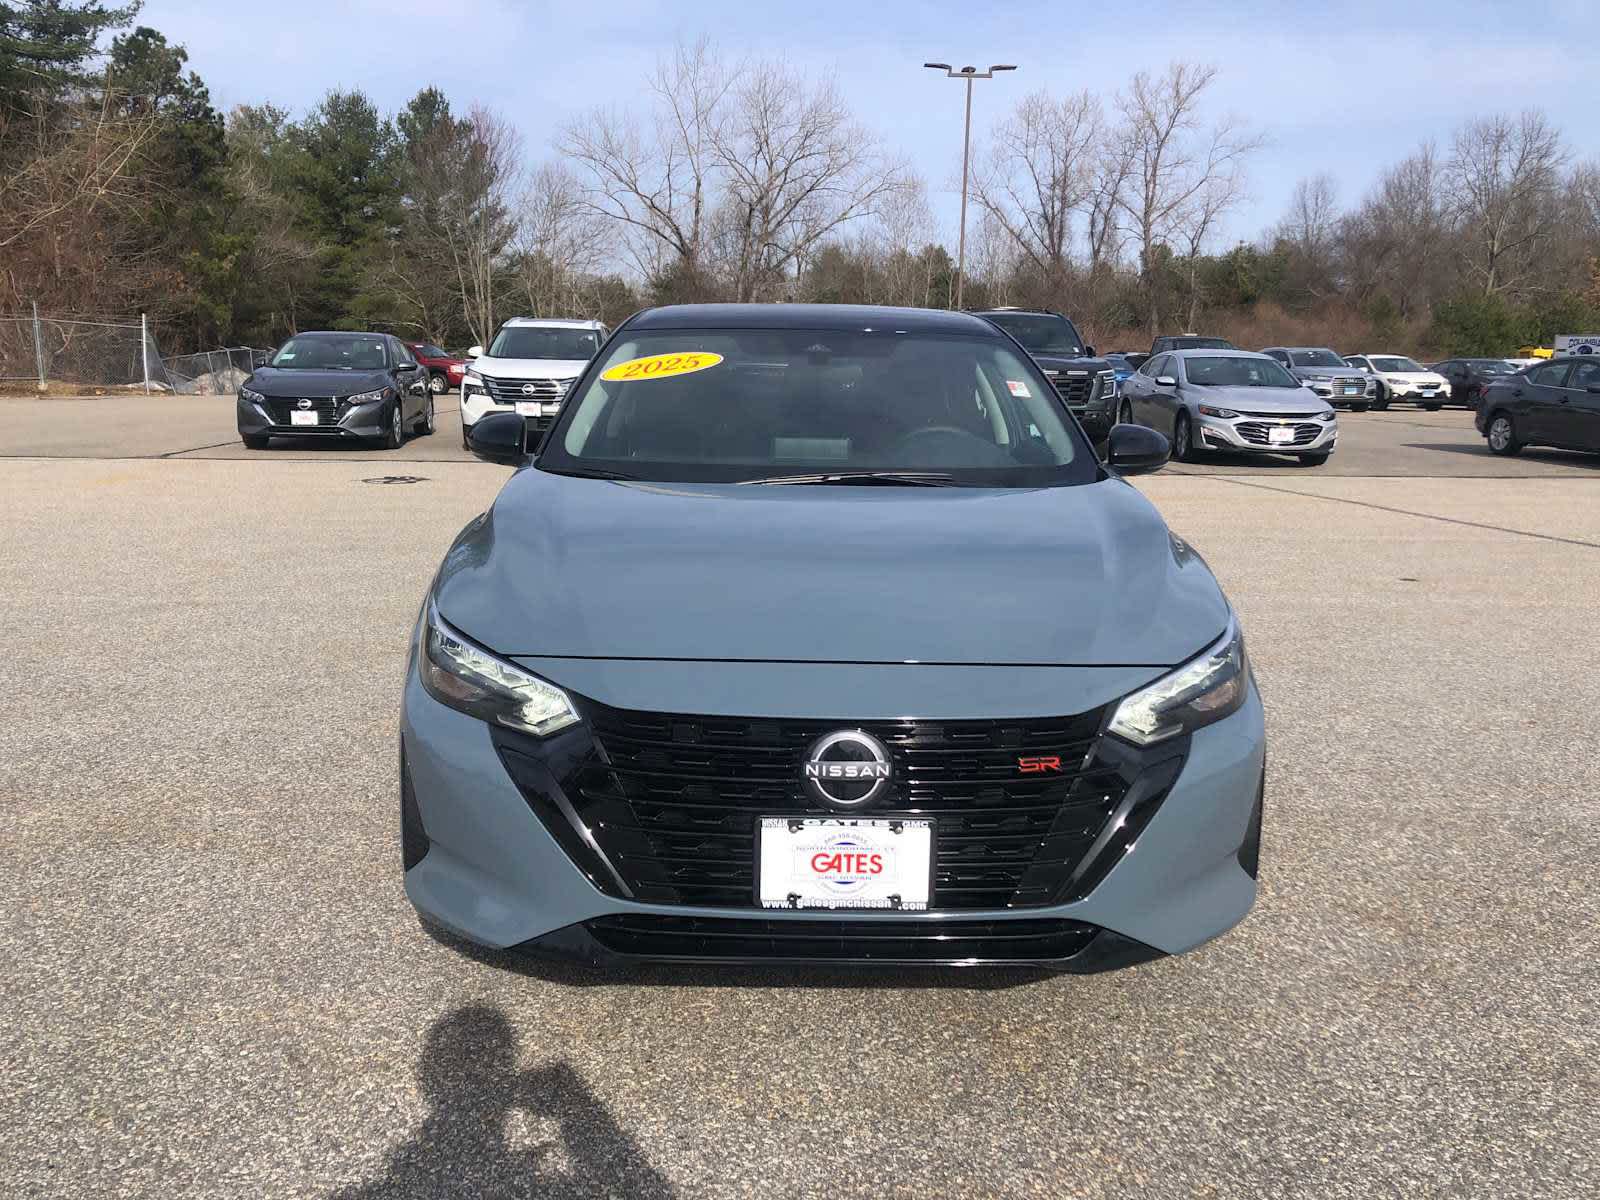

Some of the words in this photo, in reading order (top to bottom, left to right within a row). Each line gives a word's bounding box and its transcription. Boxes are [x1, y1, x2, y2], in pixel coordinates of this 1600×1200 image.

[623, 356, 700, 377] 2025
[805, 764, 890, 777] NISSAN
[1018, 756, 1062, 772] SR
[902, 820, 929, 828] GMC
[811, 852, 883, 874] GATES
